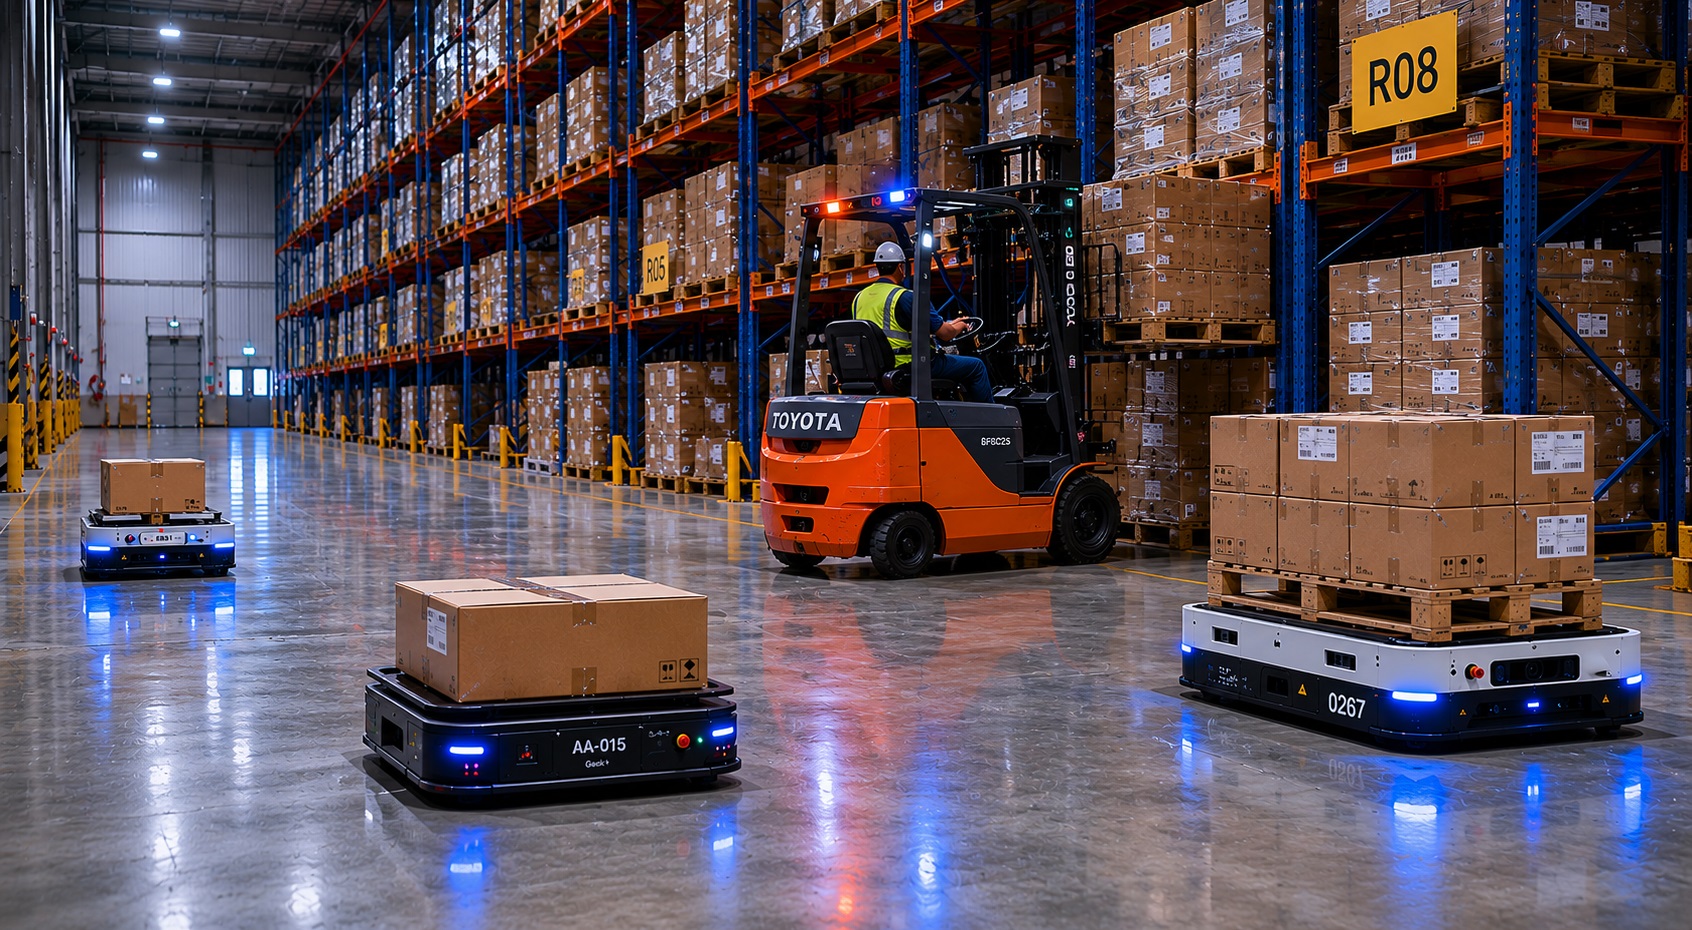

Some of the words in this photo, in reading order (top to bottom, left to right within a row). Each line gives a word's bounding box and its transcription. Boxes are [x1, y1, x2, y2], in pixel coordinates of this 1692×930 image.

[1369, 45, 1438, 106] R08
[646, 255, 666, 283] R05
[772, 411, 842, 431] TOYOTA
[1328, 692, 1366, 719] 0267
[572, 737, 626, 755] AA-015
